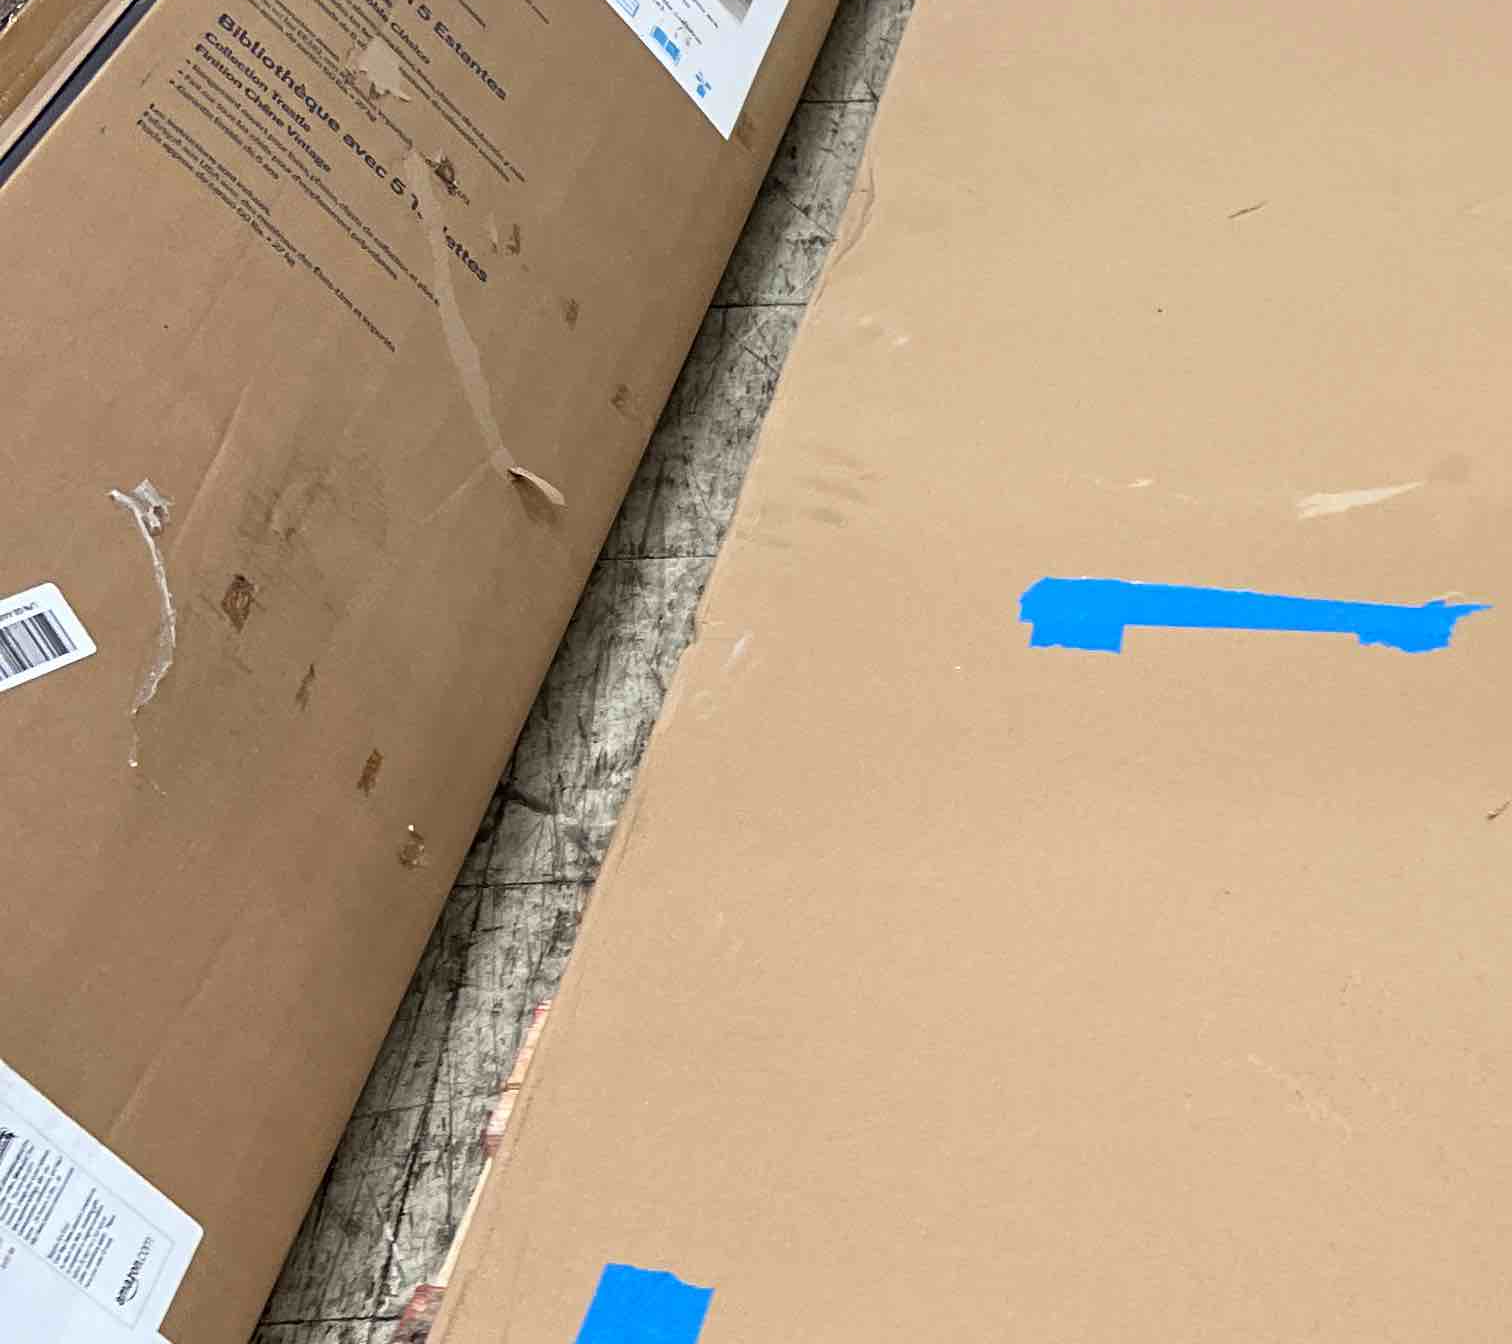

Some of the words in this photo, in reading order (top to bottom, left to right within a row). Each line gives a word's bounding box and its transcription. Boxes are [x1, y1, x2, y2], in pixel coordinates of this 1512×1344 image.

[195, 44, 243, 89] Finition
[287, 124, 332, 173] Vintage
[205, 31, 269, 93] Collection
[271, 90, 312, 133] Trestle
[217, 13, 341, 132] Bibliothèque
[343, 133, 388, 178] avec
[433, 21, 507, 101] Estantes
